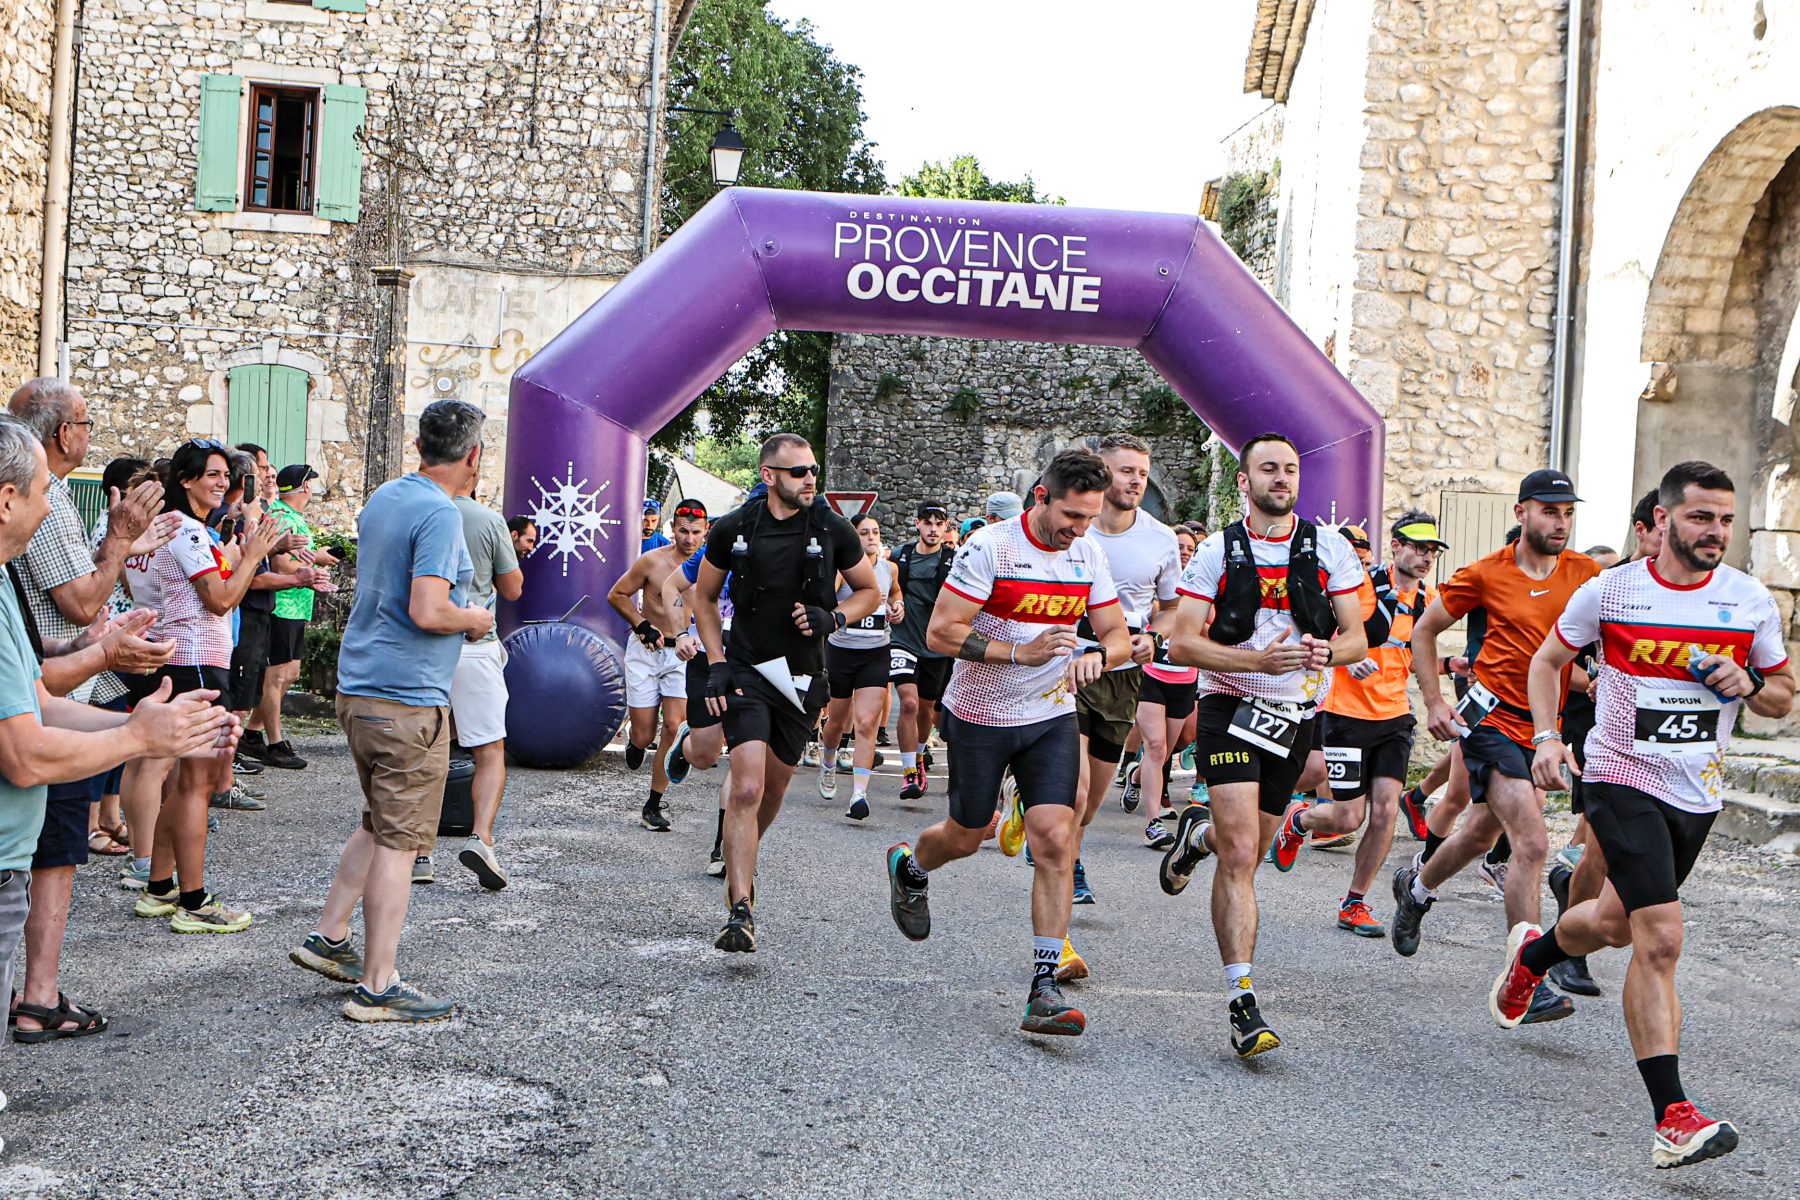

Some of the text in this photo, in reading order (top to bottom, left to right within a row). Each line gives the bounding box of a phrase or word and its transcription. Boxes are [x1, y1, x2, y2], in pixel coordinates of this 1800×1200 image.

[850, 211, 981, 226] DESTINATION
[834, 222, 1088, 273] PROVENCE
[890, 658, 907, 668] 68
[1659, 697, 1702, 705] KIPRUN
[1249, 708, 1290, 739] 127
[1658, 714, 1698, 739] 45
[1210, 751, 1250, 766] RTB16
[1327, 762, 1346, 779] 29
